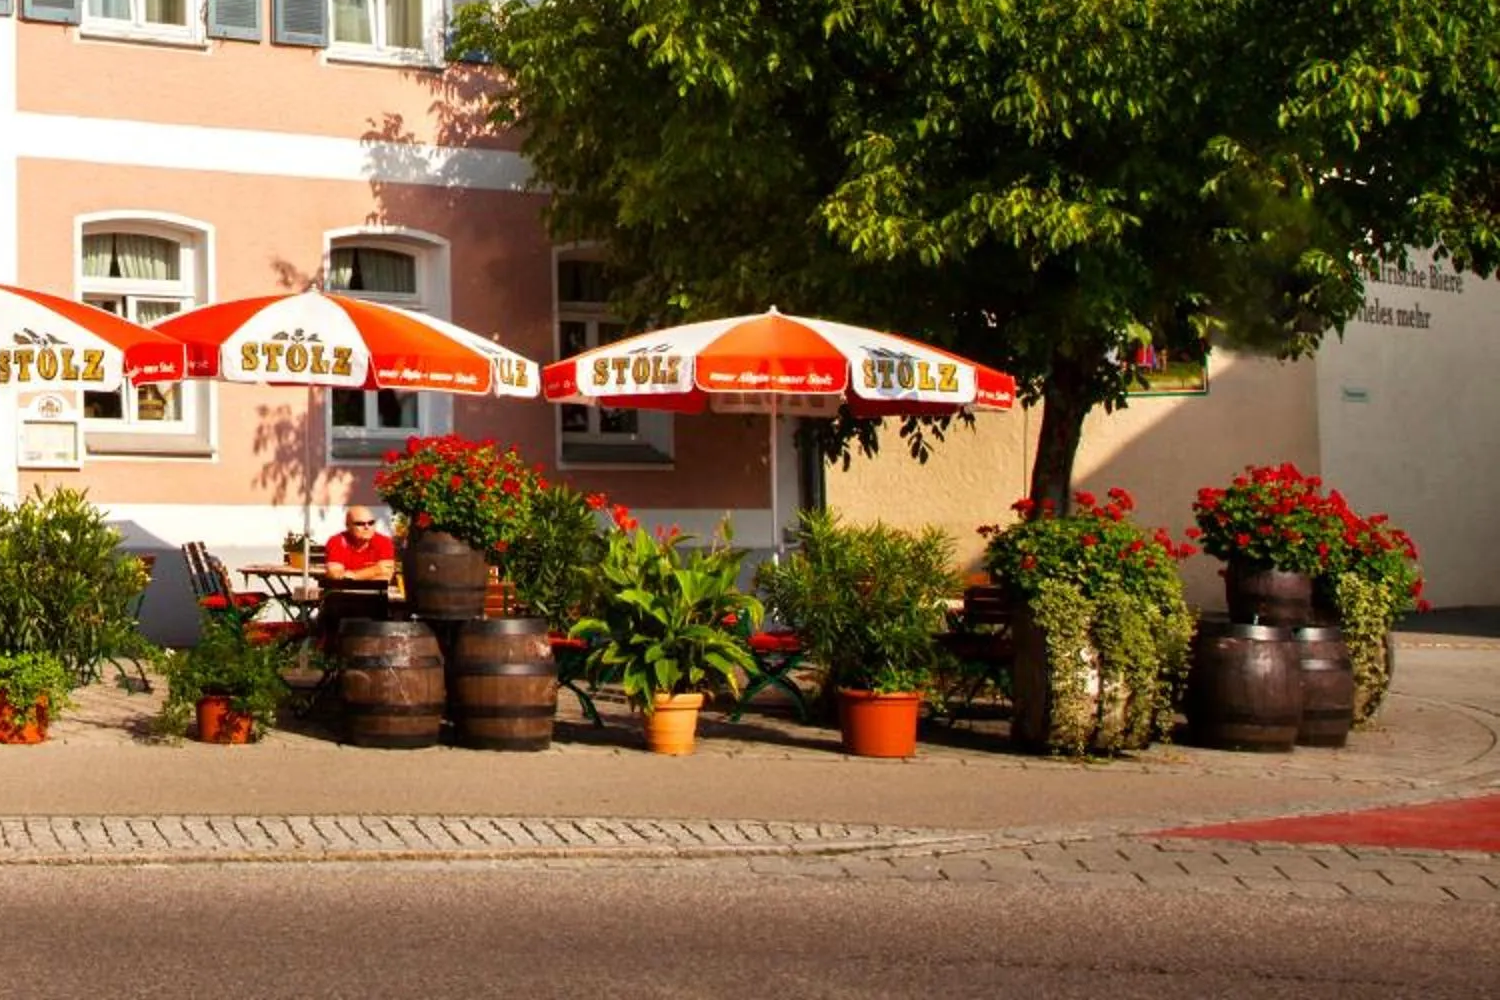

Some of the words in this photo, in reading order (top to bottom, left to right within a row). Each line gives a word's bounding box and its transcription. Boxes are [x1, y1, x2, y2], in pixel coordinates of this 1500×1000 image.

[1396, 302, 1431, 329] mehr
[241, 342, 353, 376] STOLZ
[593, 355, 682, 385] STOLZ
[862, 358, 959, 392] STOLZ
